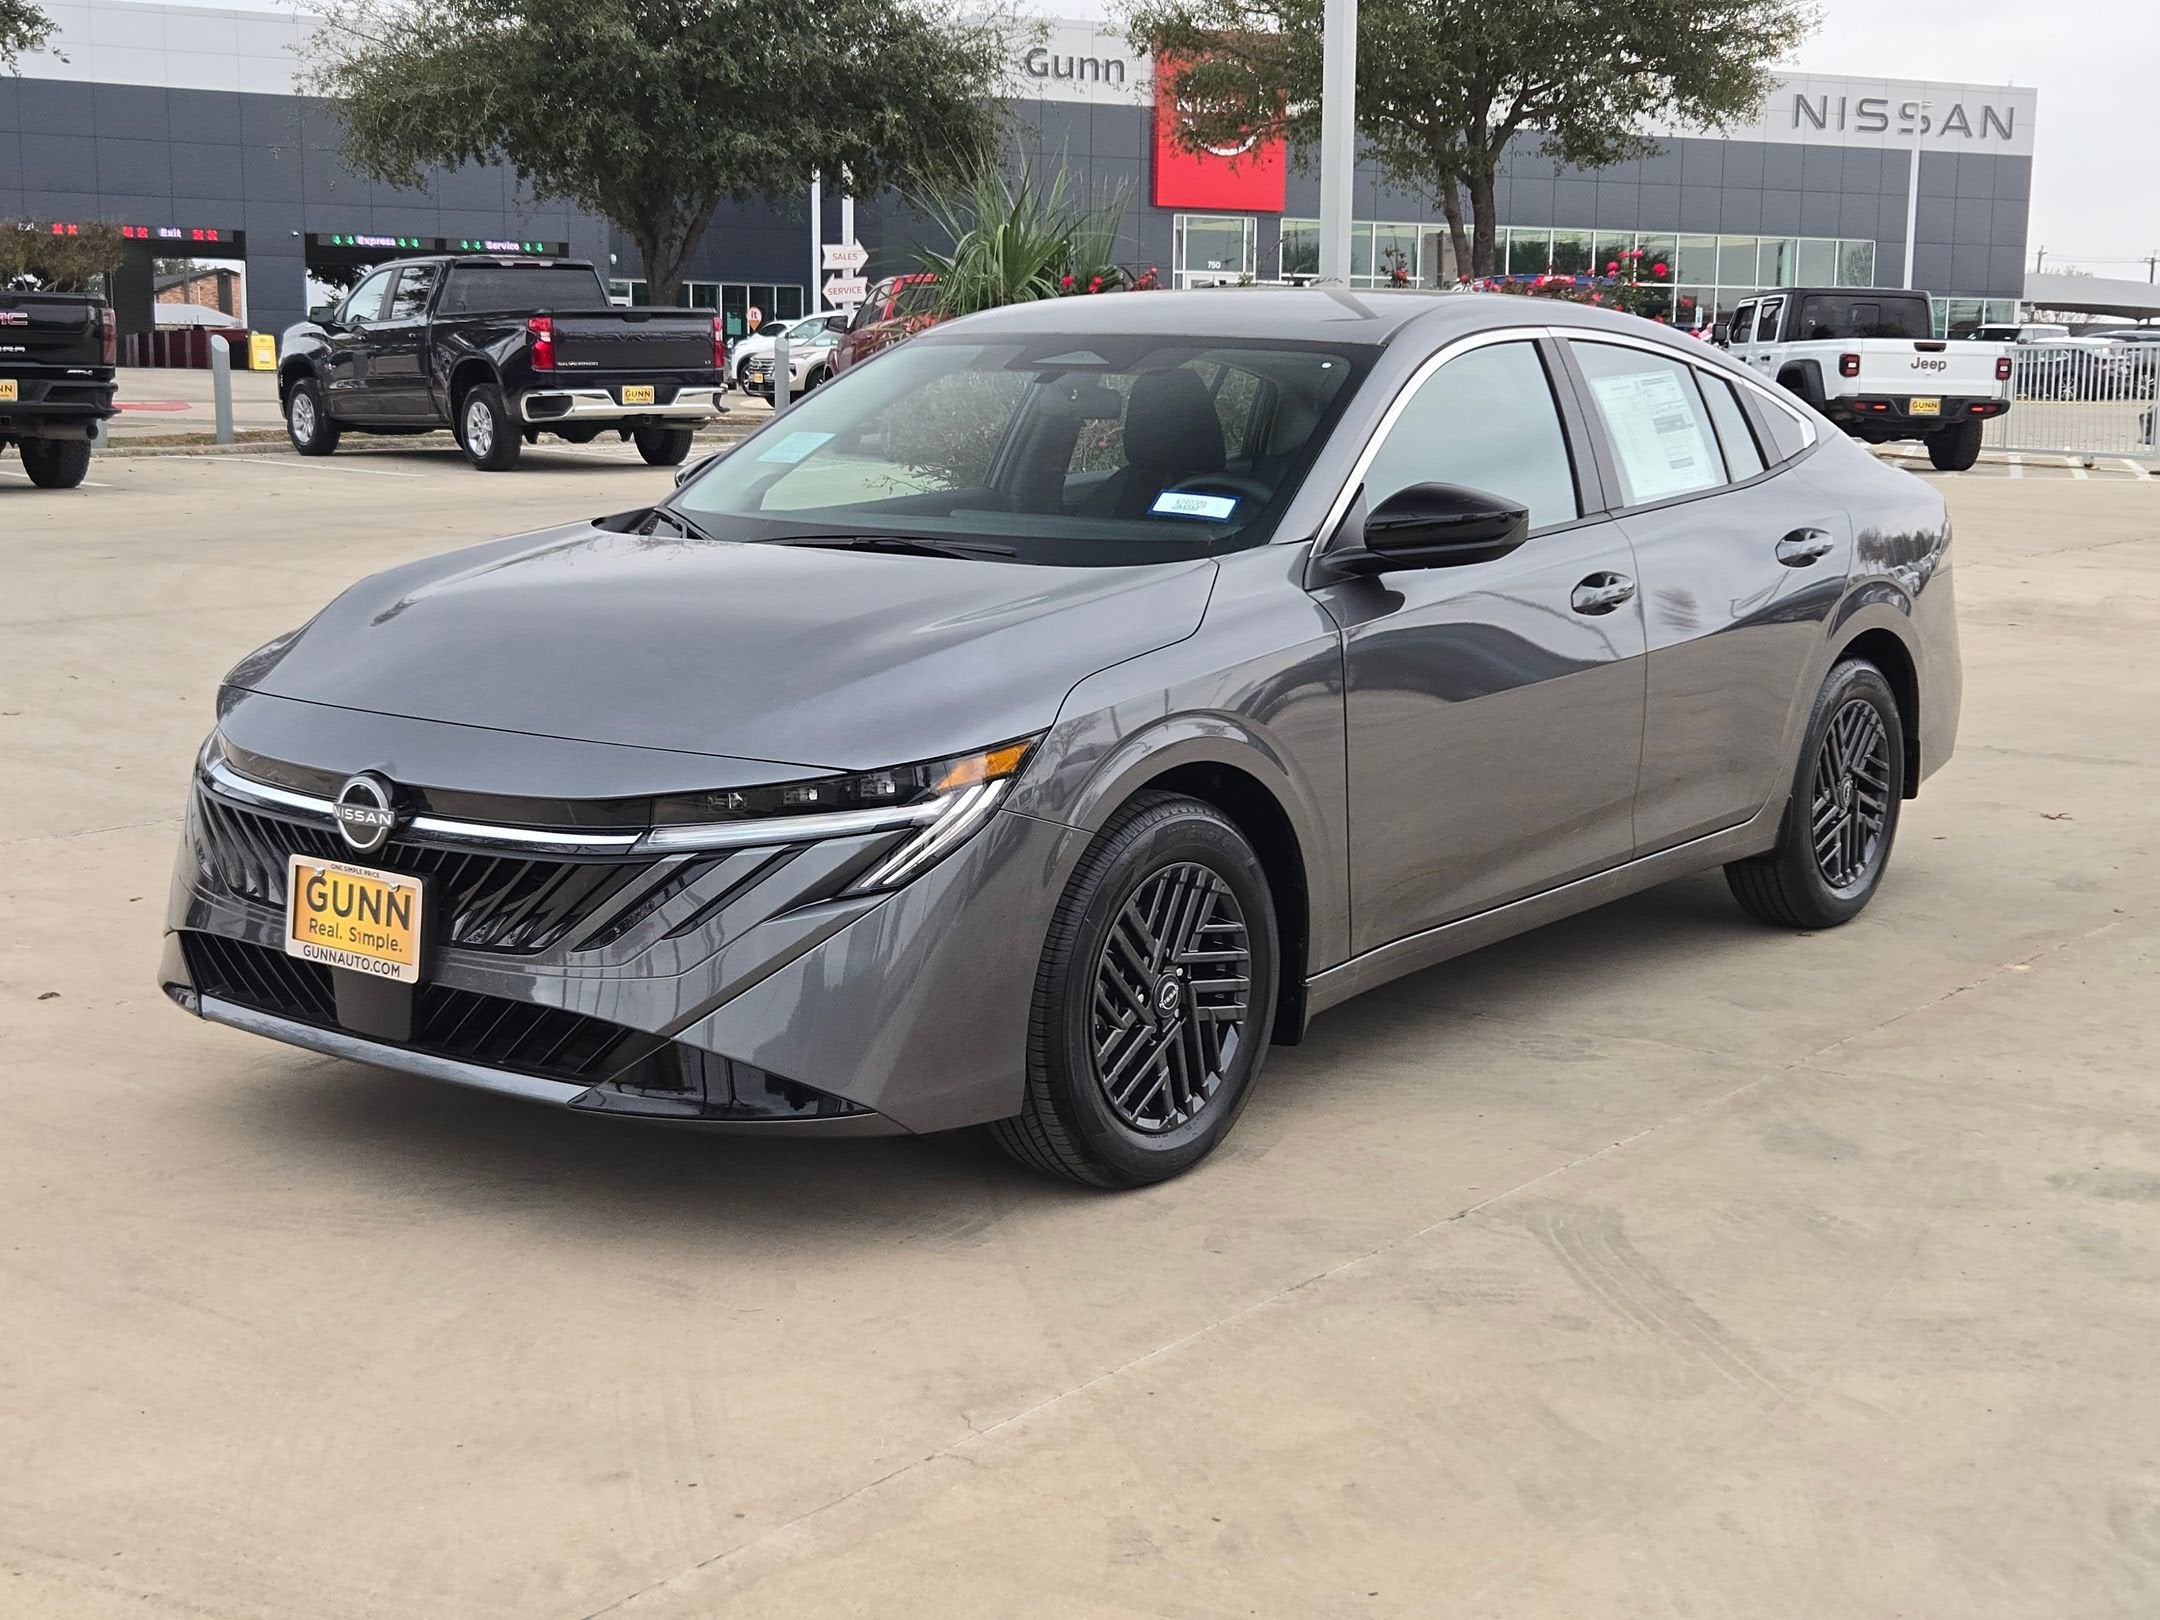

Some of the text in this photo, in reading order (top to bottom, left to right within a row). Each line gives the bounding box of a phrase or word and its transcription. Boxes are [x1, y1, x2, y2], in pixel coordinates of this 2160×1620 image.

[1025, 48, 1125, 82] Gunn
[1793, 93, 2015, 140] NISSAN
[160, 227, 181, 238] Exit
[357, 235, 396, 247] Express
[486, 239, 520, 251] Service
[832, 252, 858, 261] SALES
[1207, 261, 1221, 269] 750
[828, 286, 862, 296] SERVICE
[1910, 357, 1947, 372] Jeep
[625, 390, 651, 398] GUNN
[1912, 401, 1938, 409] GUNN
[333, 805, 392, 825] NISSAN
[330, 863, 343, 871] ONE
[363, 869, 380, 879] PRICE
[306, 875, 411, 931] GUNN
[309, 918, 342, 940] Real.
[303, 944, 400, 977] GUNNAUTO.COM
